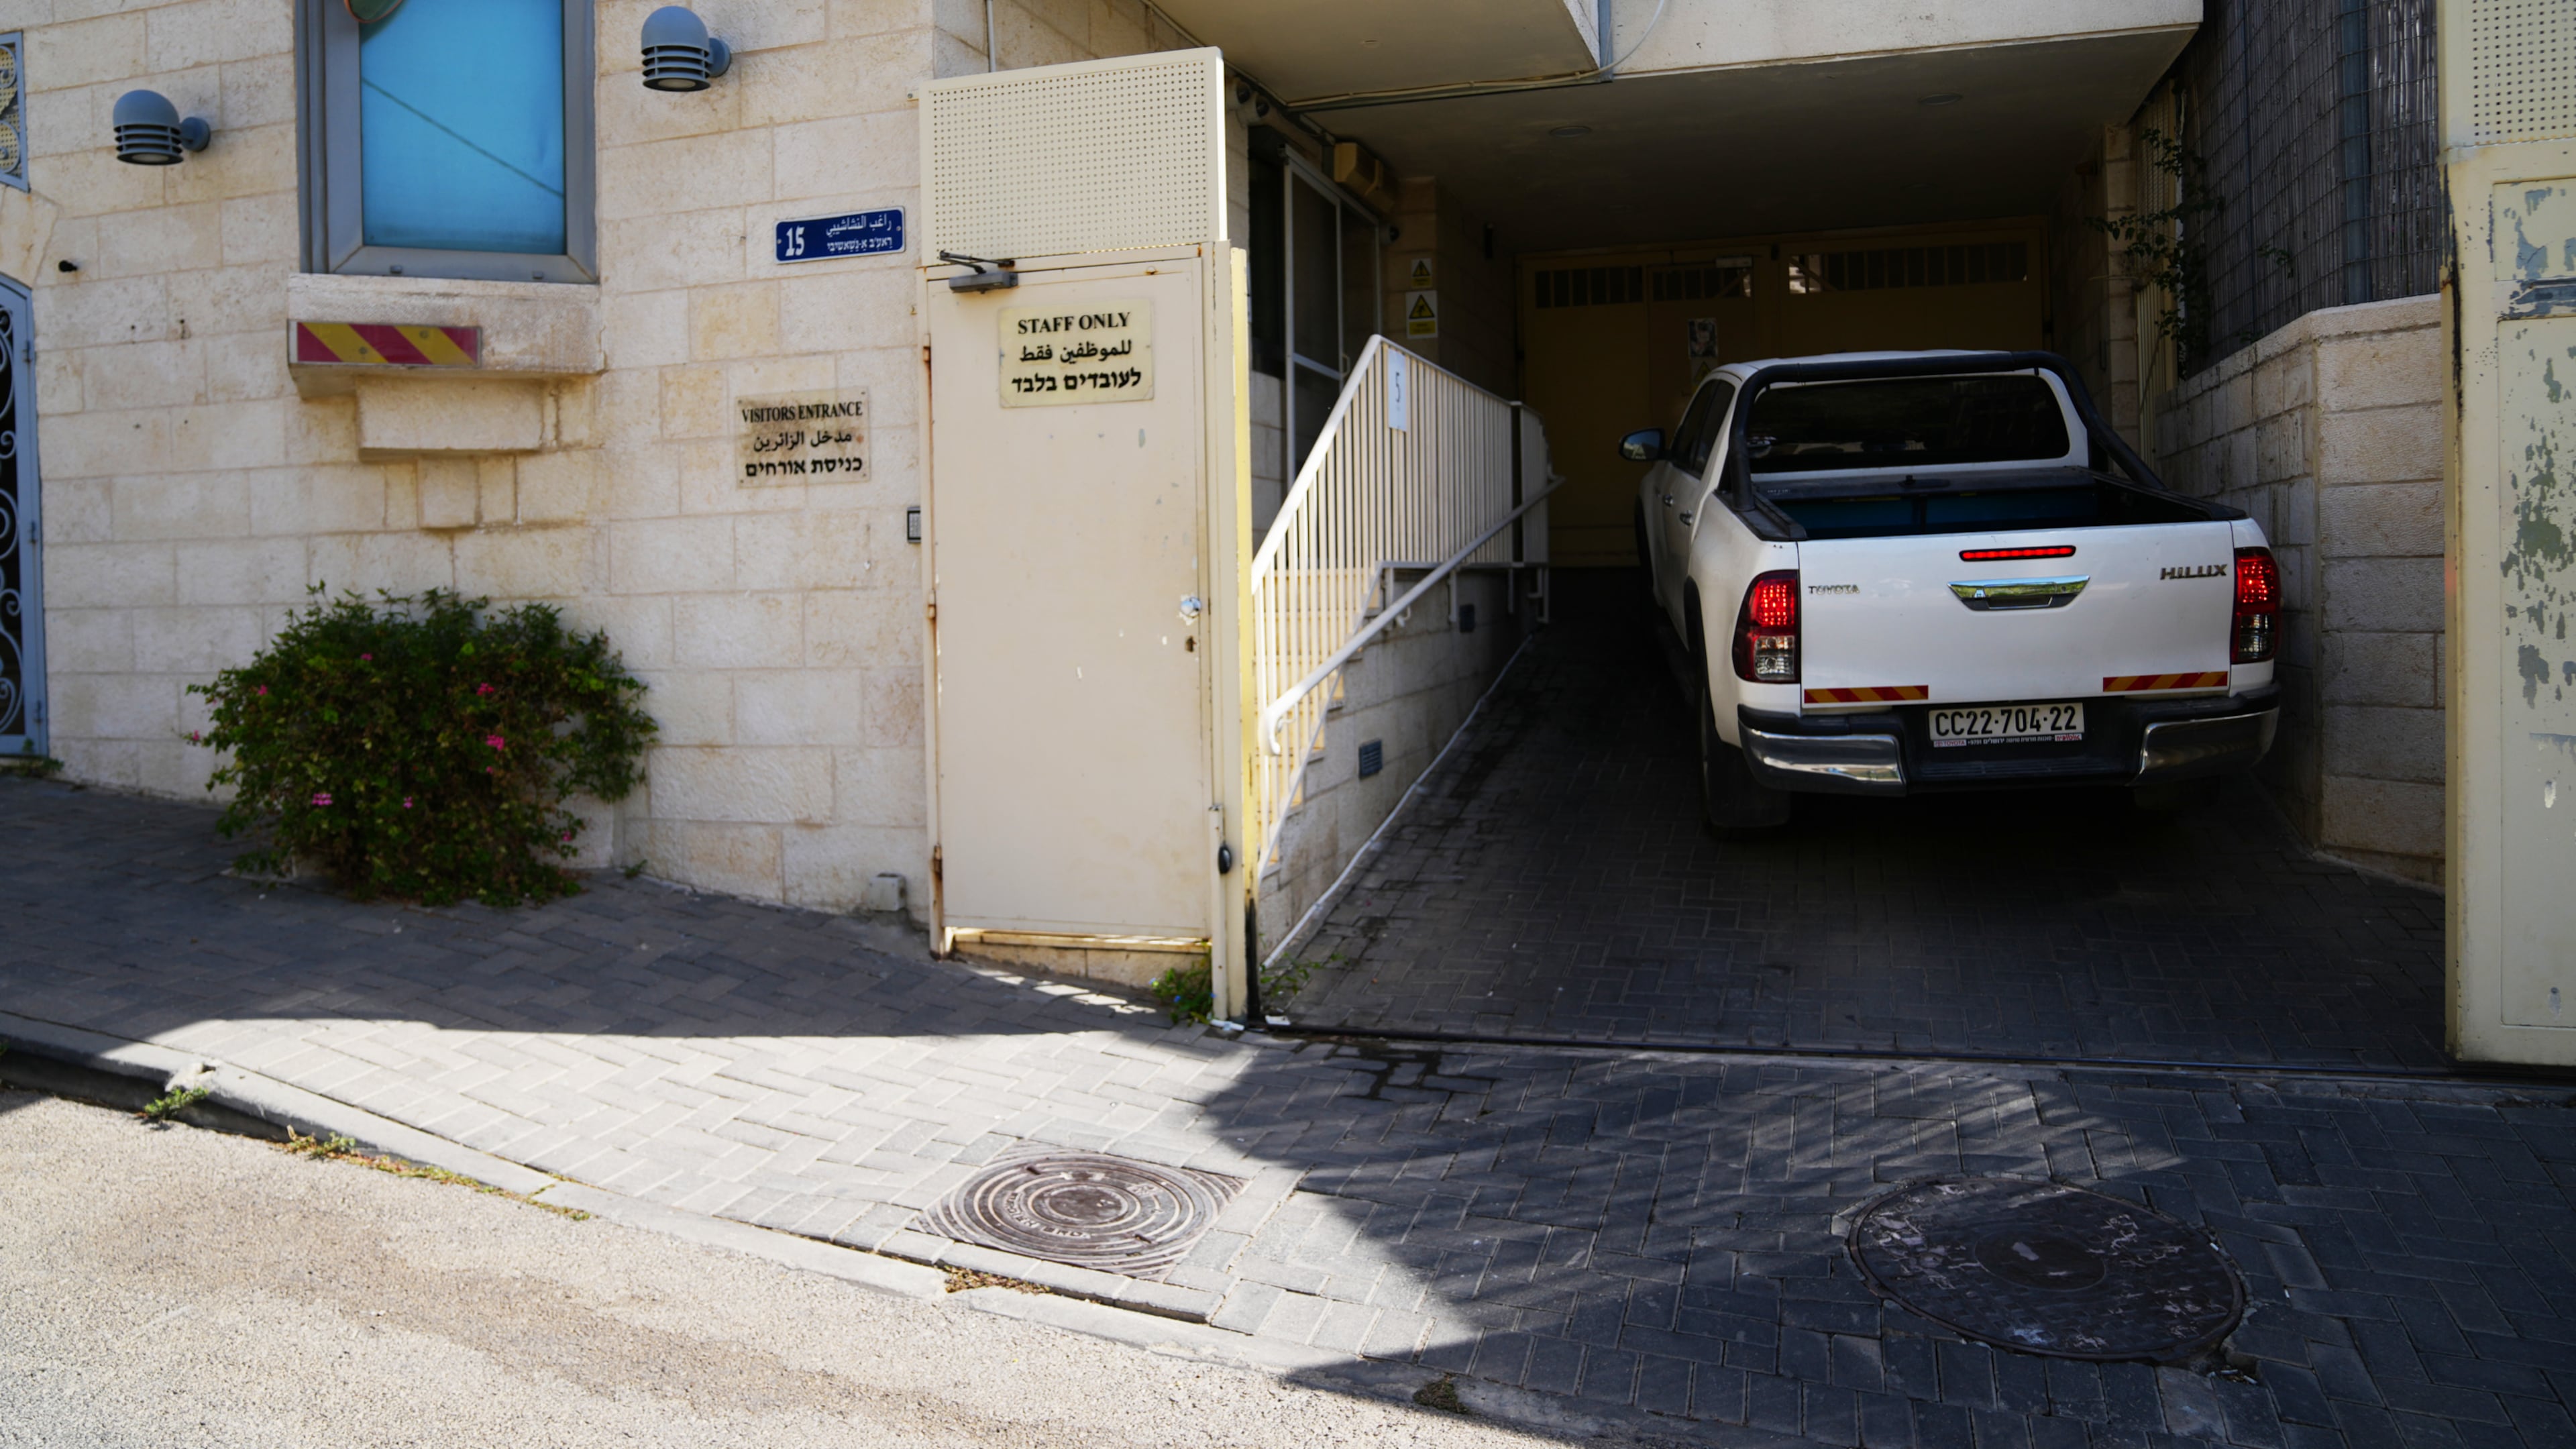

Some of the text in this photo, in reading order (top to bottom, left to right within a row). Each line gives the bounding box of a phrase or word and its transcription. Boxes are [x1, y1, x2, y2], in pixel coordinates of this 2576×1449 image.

[826, 213, 892, 237] راغب النشاشيبي
[785, 225, 805, 257] 15
[1017, 311, 1131, 335] STAFF ONLY
[1019, 339, 1132, 364] للموظفين فقط
[1011, 366, 1142, 393] לעובדים בלבד
[742, 401, 863, 423] VISITORS ENTRANCE
[753, 429, 853, 453] مدخل الزائرين
[745, 457, 863, 477] כניסת אורחים
[2159, 564, 2229, 580] HILUX
[1807, 584, 1860, 595] TOYOTA
